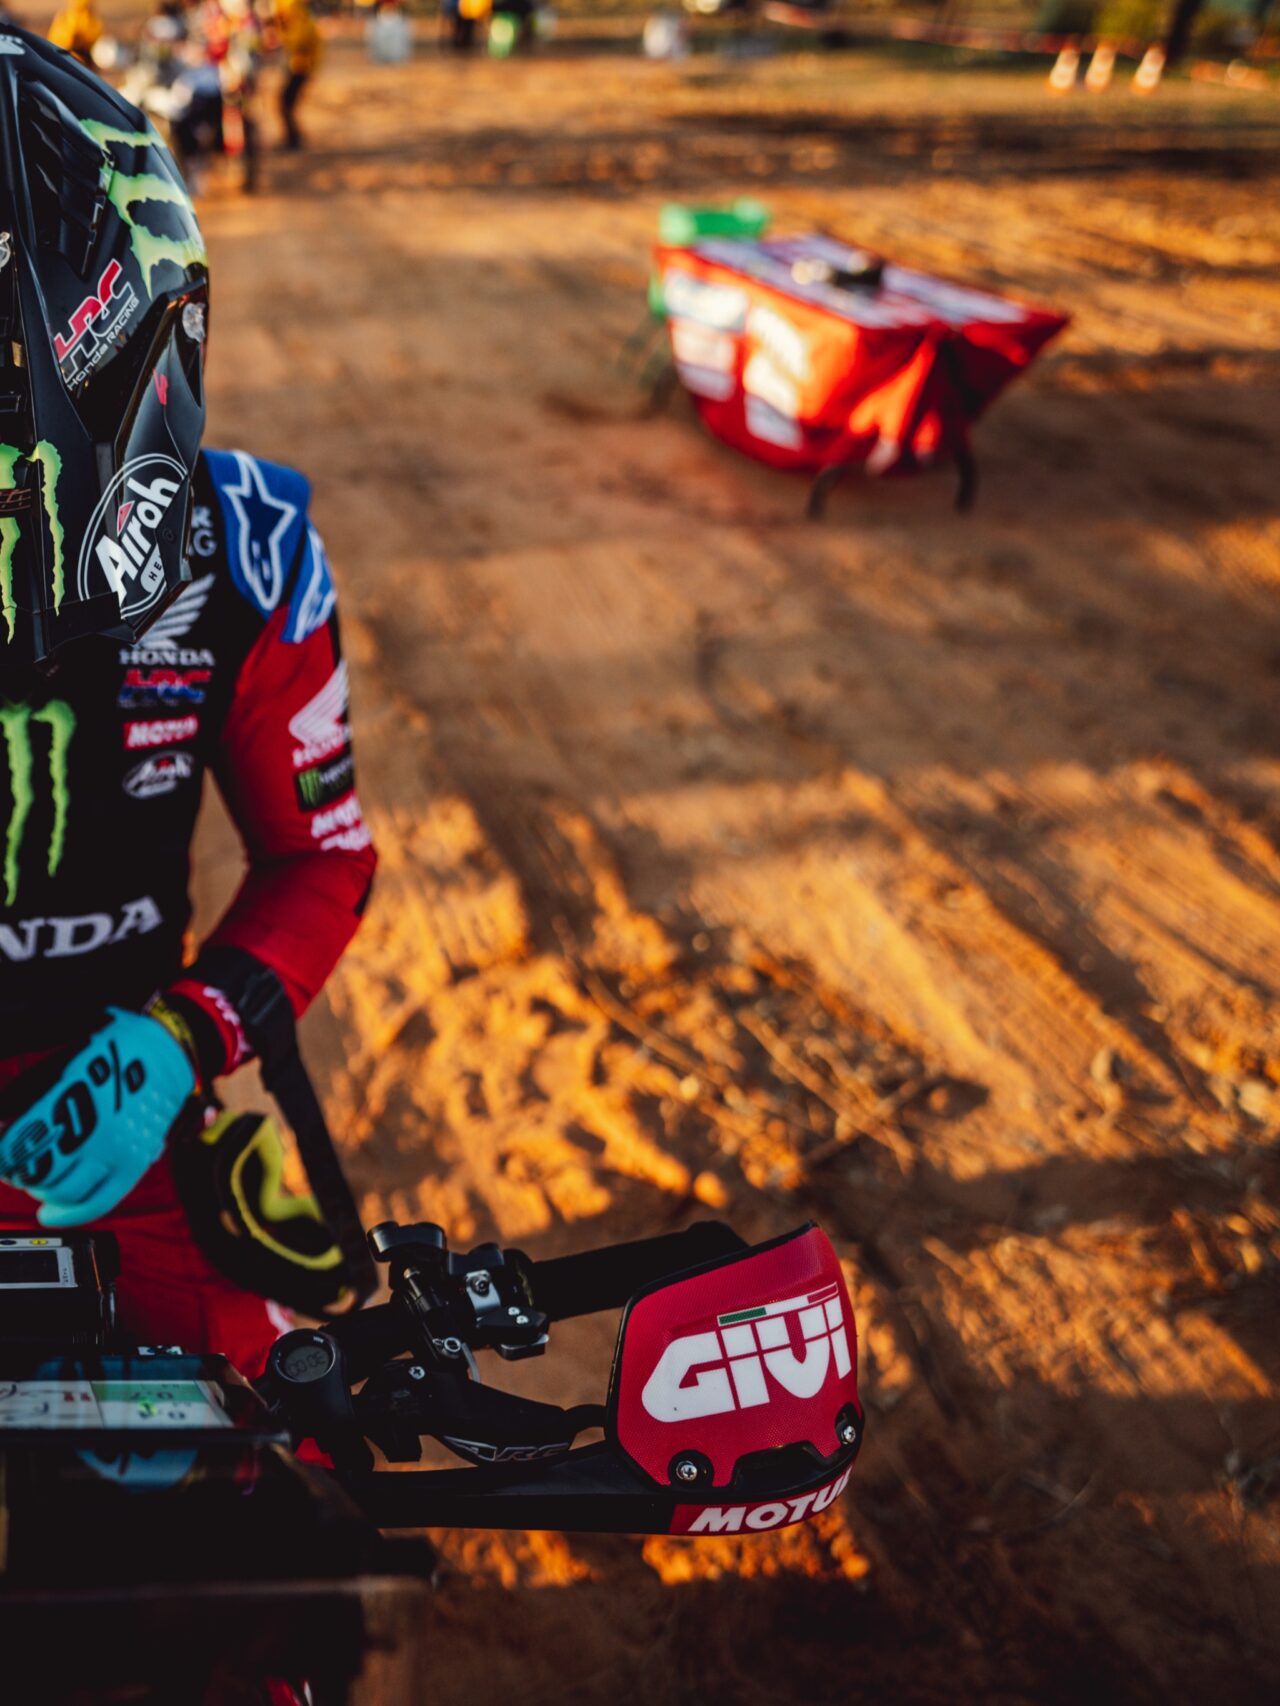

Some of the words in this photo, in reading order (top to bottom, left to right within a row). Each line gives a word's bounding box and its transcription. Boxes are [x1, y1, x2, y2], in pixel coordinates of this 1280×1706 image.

[54, 258, 134, 383] HRC
[67, 344, 109, 391] Honda
[106, 296, 140, 344] RACING
[95, 476, 180, 607] Airoh
[120, 649, 215, 666] HONDA
[642, 1296, 852, 1423] GIVI
